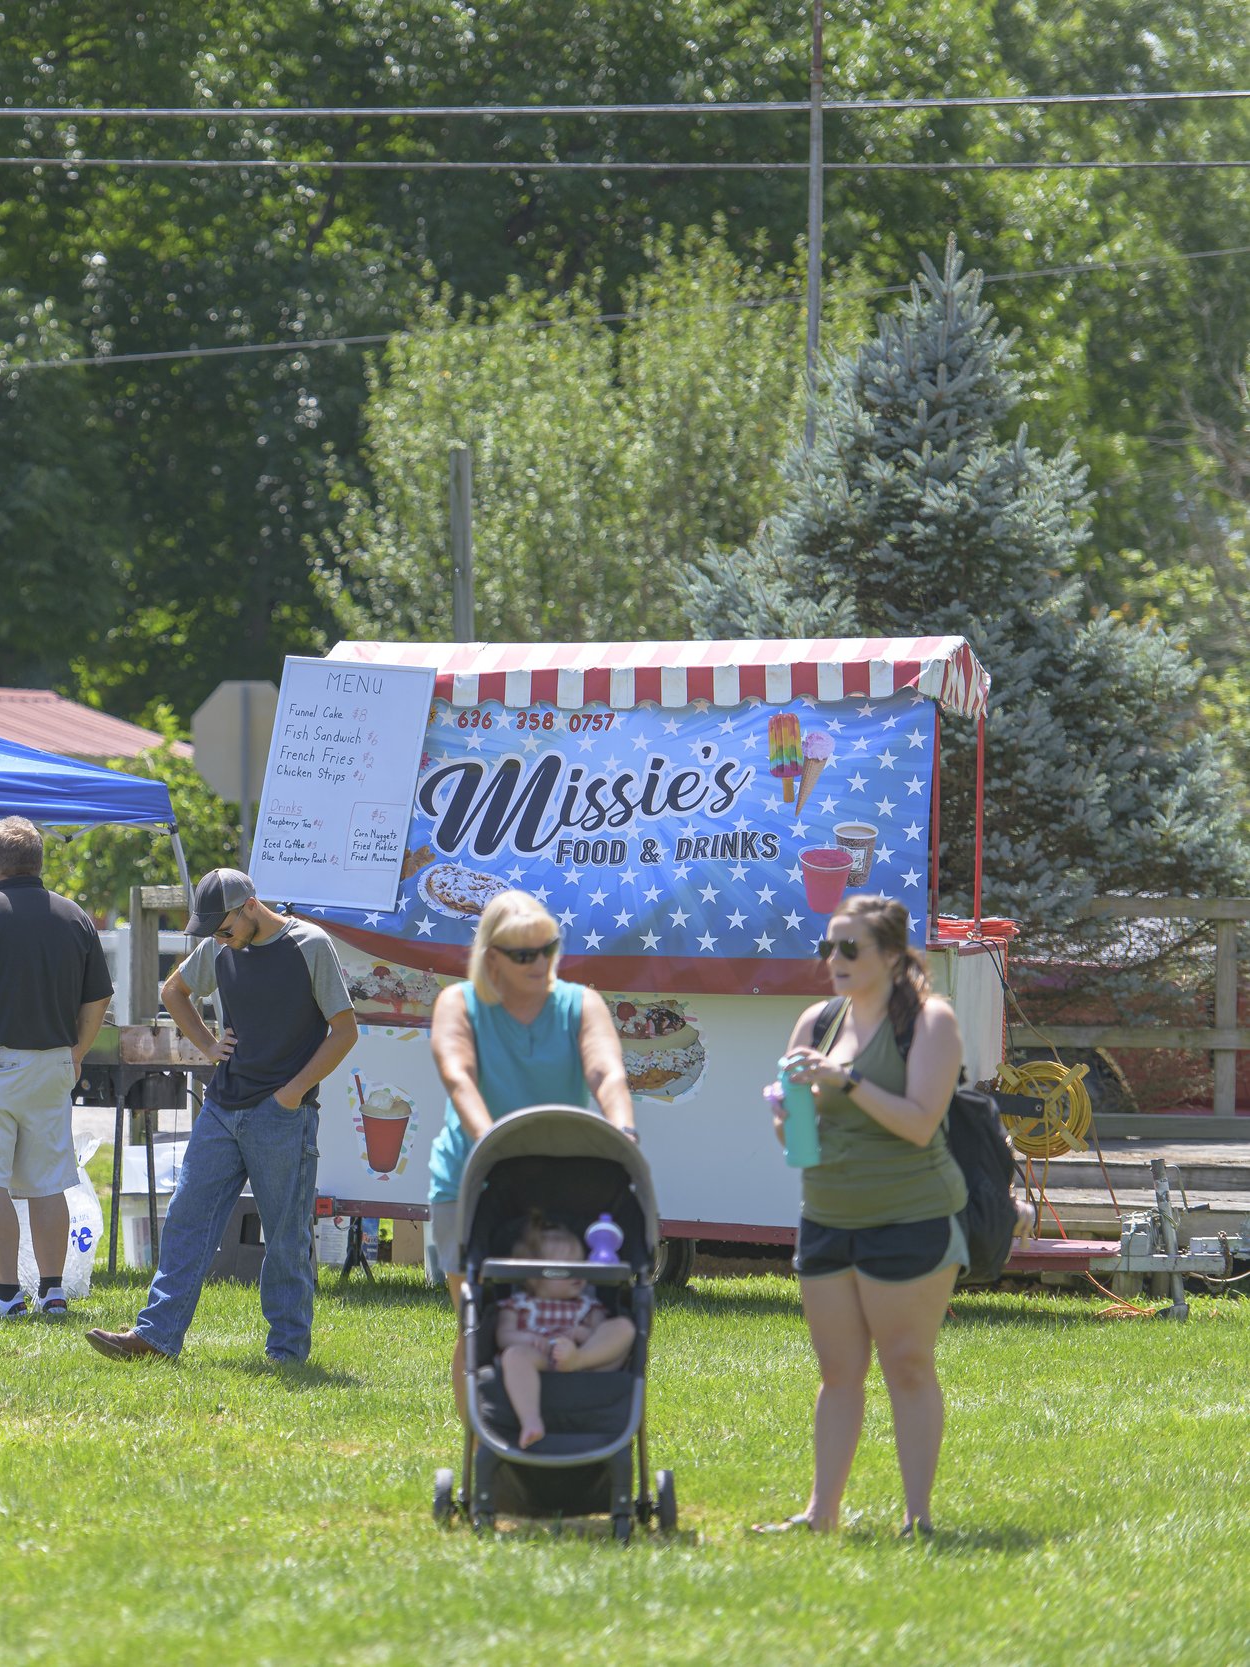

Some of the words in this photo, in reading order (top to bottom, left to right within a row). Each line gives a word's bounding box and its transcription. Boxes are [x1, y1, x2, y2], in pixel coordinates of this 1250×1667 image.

[326, 672, 382, 694] MENU
[289, 703, 318, 717] Funnel
[323, 706, 343, 719] Cake
[457, 709, 493, 730] 636
[516, 711, 554, 731] 358
[568, 712, 615, 732] 0757
[285, 724, 308, 740] Fish
[314, 726, 361, 744] Sandwich
[280, 745, 314, 761] French
[322, 747, 355, 765] Fries
[277, 764, 312, 778] Chicken
[318, 767, 346, 785] Strips
[270, 799, 302, 814] Drinks
[418, 745, 751, 856] Missie's
[267, 816, 299, 829] Raspberry
[302, 819, 312, 828] Tea
[354, 828, 368, 837] Corn
[370, 829, 397, 842] Nuggets
[263, 839, 281, 848] Iced
[285, 839, 305, 849] Coffee
[353, 840, 371, 850] Fried
[375, 842, 398, 851] Pickles
[555, 839, 628, 867] FOOD
[639, 838, 661, 864] &
[675, 831, 780, 862] DRINKS
[261, 851, 275, 861] Blue
[278, 851, 310, 865] Raspberry
[311, 852, 327, 863] Punch
[350, 851, 368, 861] Fried
